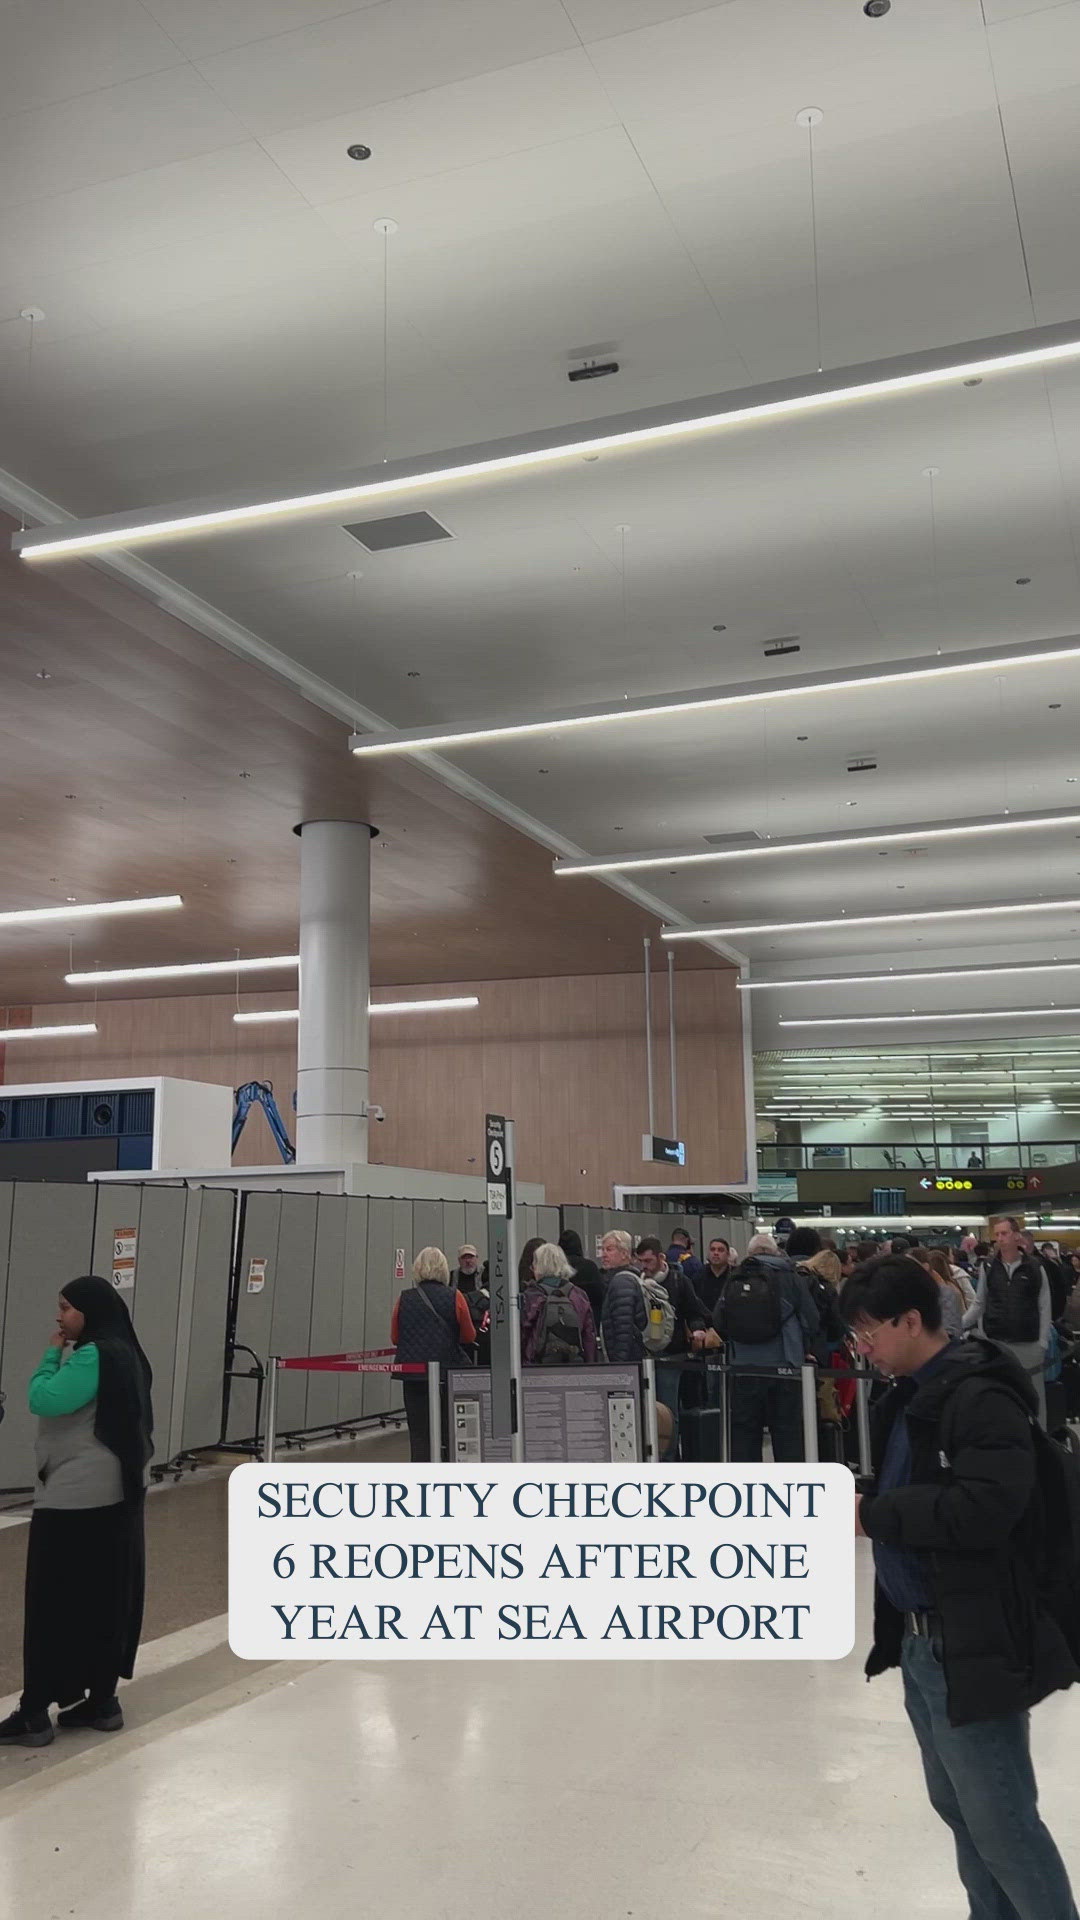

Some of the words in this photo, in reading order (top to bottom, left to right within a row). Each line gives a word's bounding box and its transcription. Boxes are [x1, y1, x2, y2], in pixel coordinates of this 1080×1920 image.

[493, 1146, 500, 1170] 5
[495, 1241, 504, 1278] Pre
[495, 1285, 504, 1330] TSA
[358, 1363, 390, 1372] EMERGENCY
[391, 1363, 403, 1372] EXIT
[777, 1367, 793, 1375] SEA
